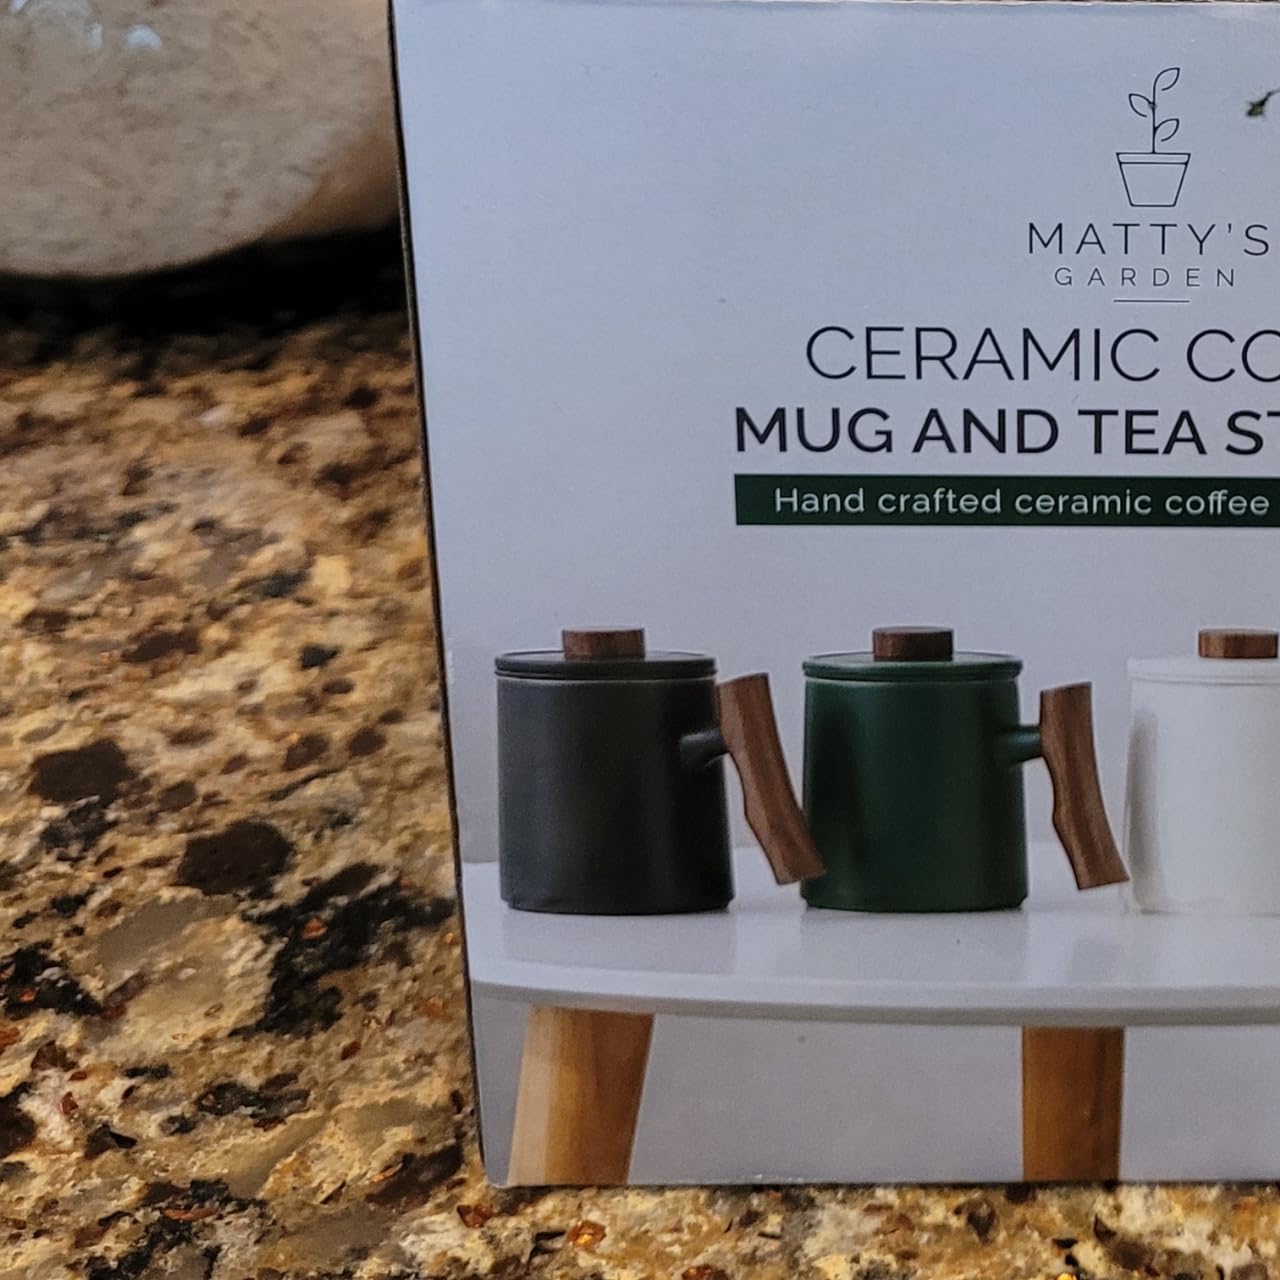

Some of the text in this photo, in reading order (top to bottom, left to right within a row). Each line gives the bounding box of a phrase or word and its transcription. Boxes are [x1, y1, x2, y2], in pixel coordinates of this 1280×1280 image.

[1028, 221, 1270, 257] MATTY'S
[1054, 267, 1236, 288] GARDEN
[805, 325, 1161, 383] CERAMIC
[735, 406, 894, 454] MUG
[911, 407, 1060, 455] AND
[1077, 408, 1209, 456] TEA
[774, 487, 865, 514] Hand
[877, 487, 1002, 515] crafted
[1014, 488, 1152, 516] ceramic
[1164, 488, 1270, 516] coffee
